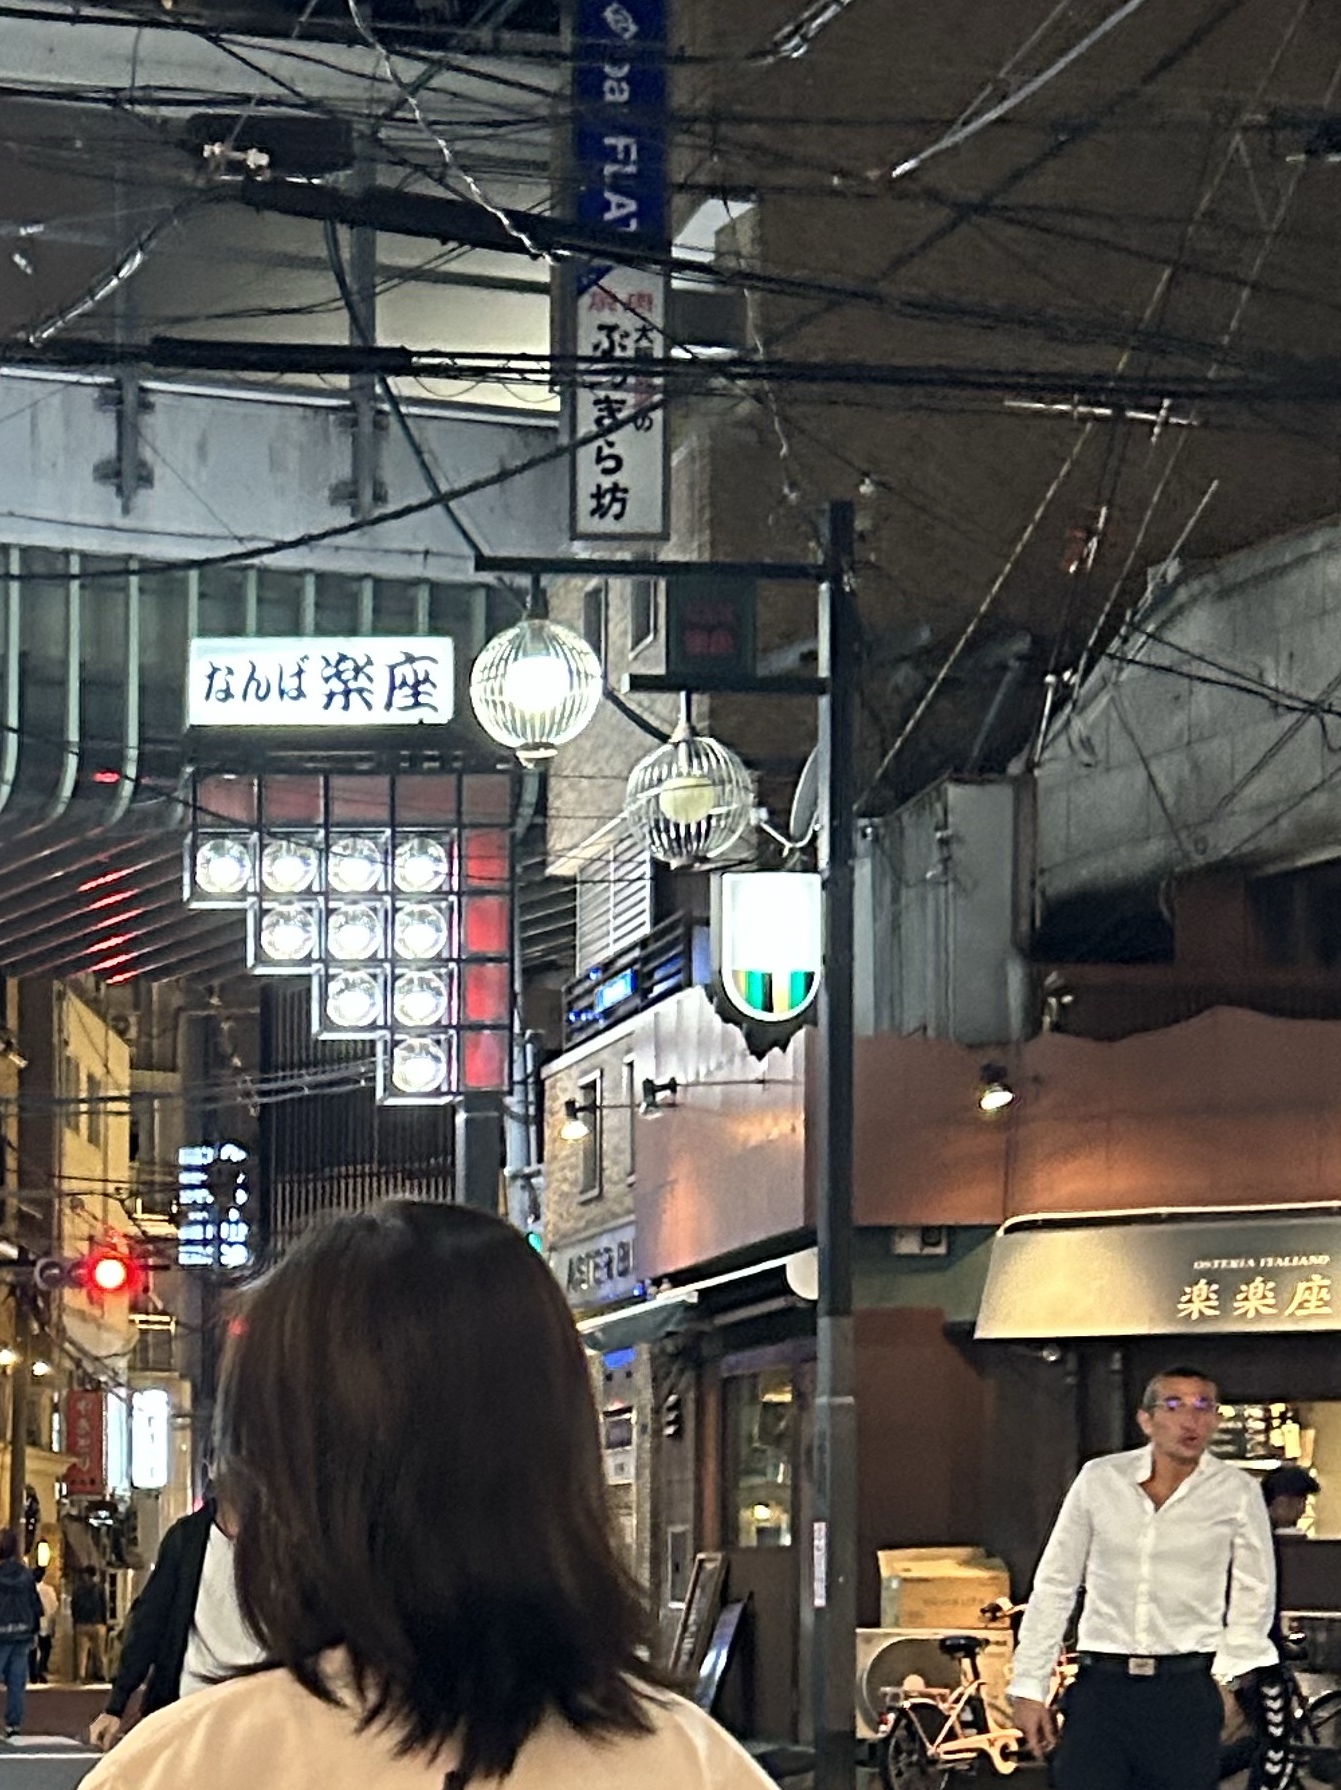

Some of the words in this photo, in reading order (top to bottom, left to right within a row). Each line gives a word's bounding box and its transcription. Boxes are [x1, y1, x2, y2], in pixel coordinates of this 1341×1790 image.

[205, 651, 439, 713] なんば楽座
[1176, 1274, 1334, 1321] 楽楽座
